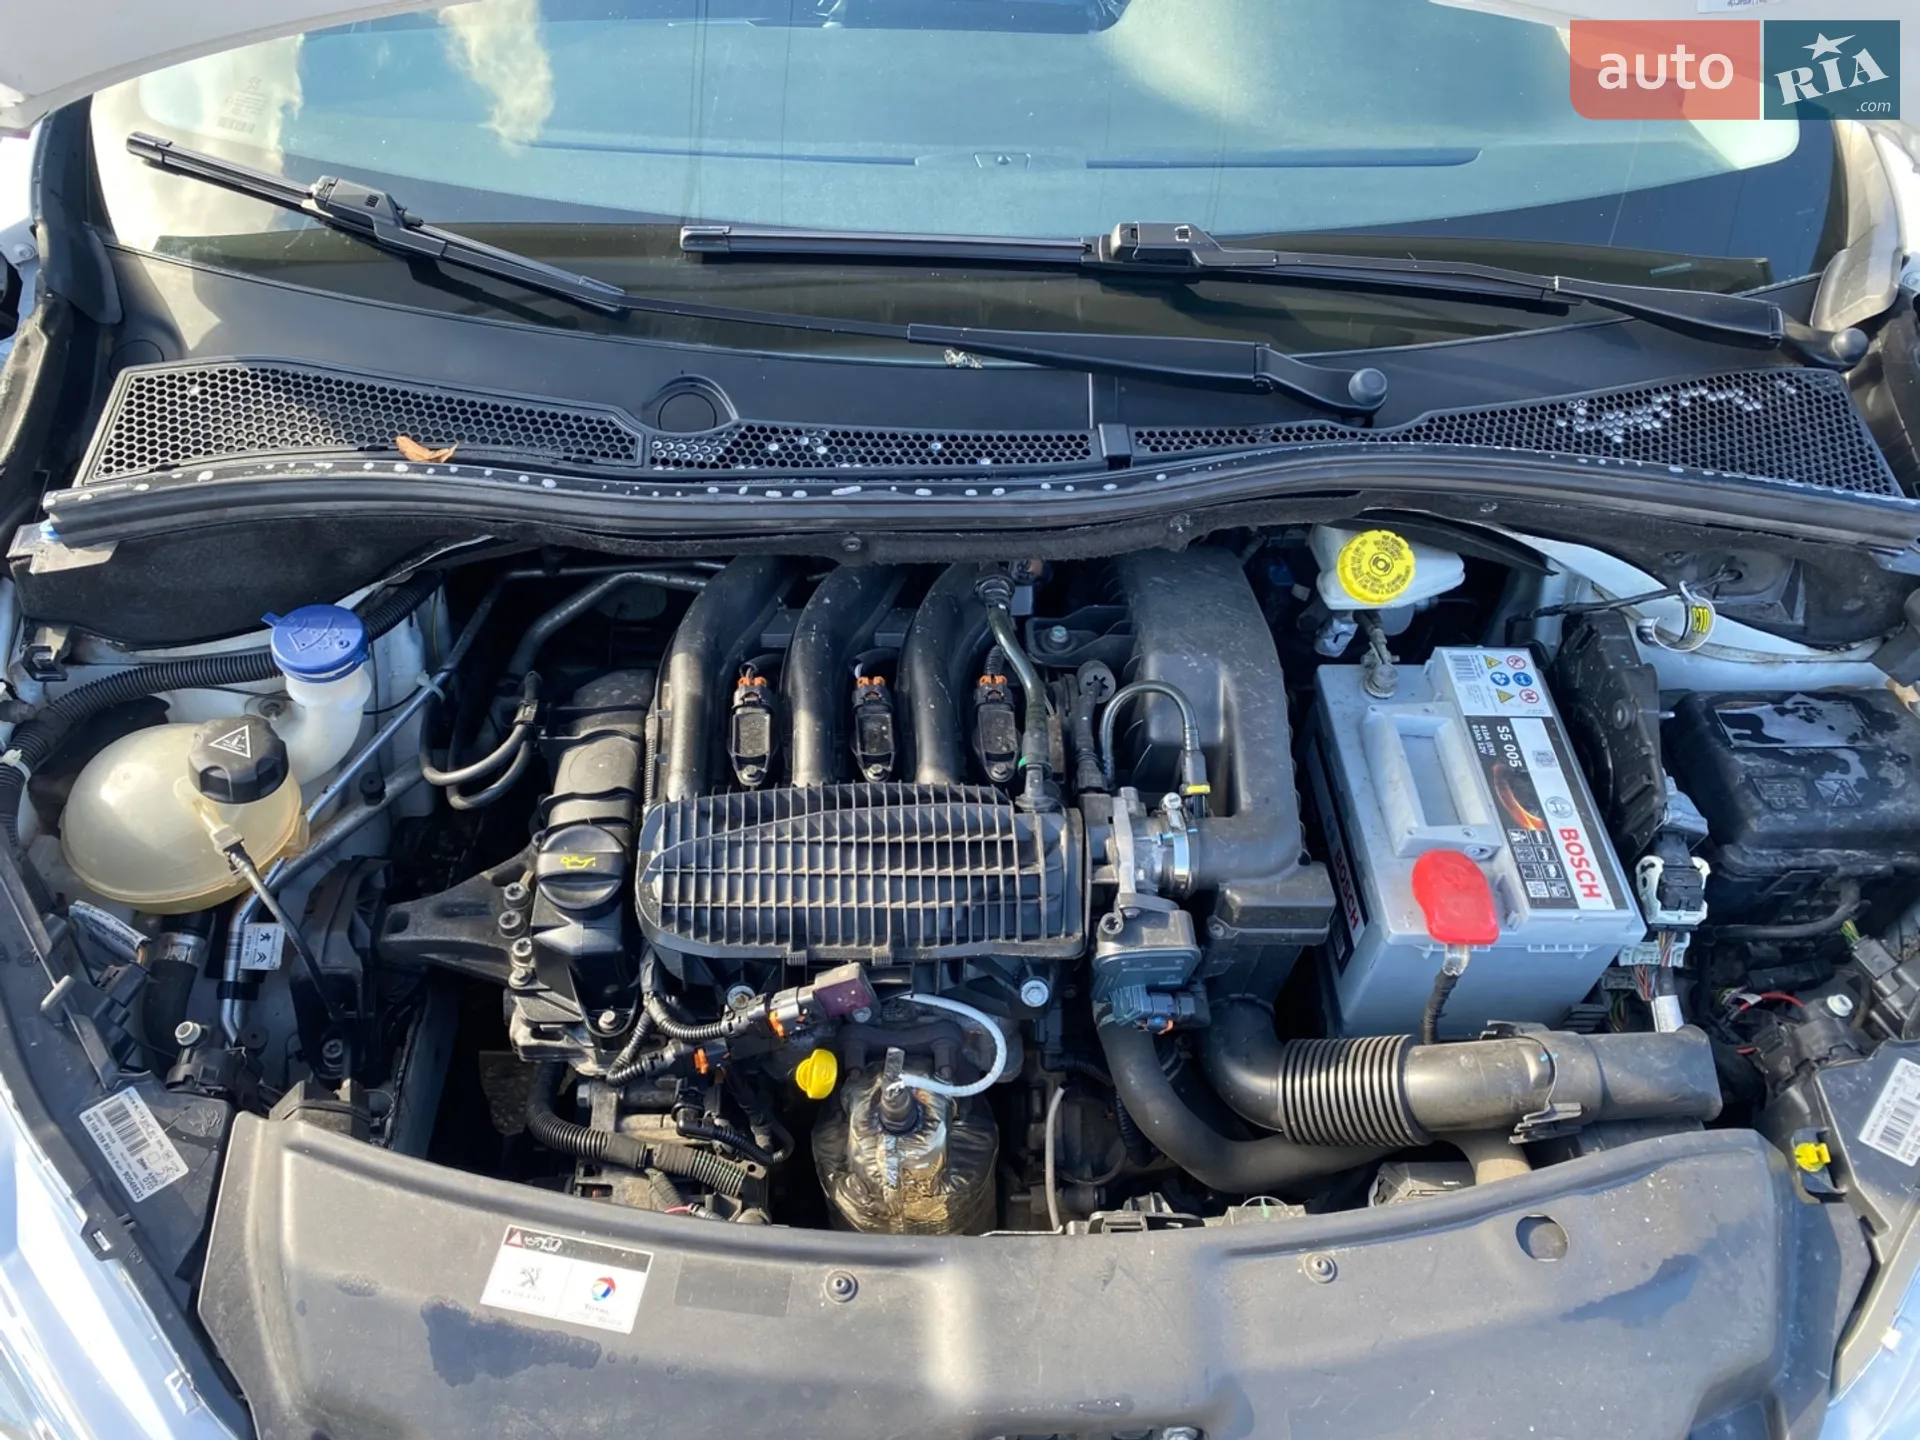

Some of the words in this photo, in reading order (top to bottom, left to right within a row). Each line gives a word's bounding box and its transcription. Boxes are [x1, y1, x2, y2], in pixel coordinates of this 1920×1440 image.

[1497, 725, 1513, 741] S5
[1503, 743, 1522, 768] 005
[1558, 827, 1602, 899] BOSCH
[1335, 850, 1359, 931] BOSCH
